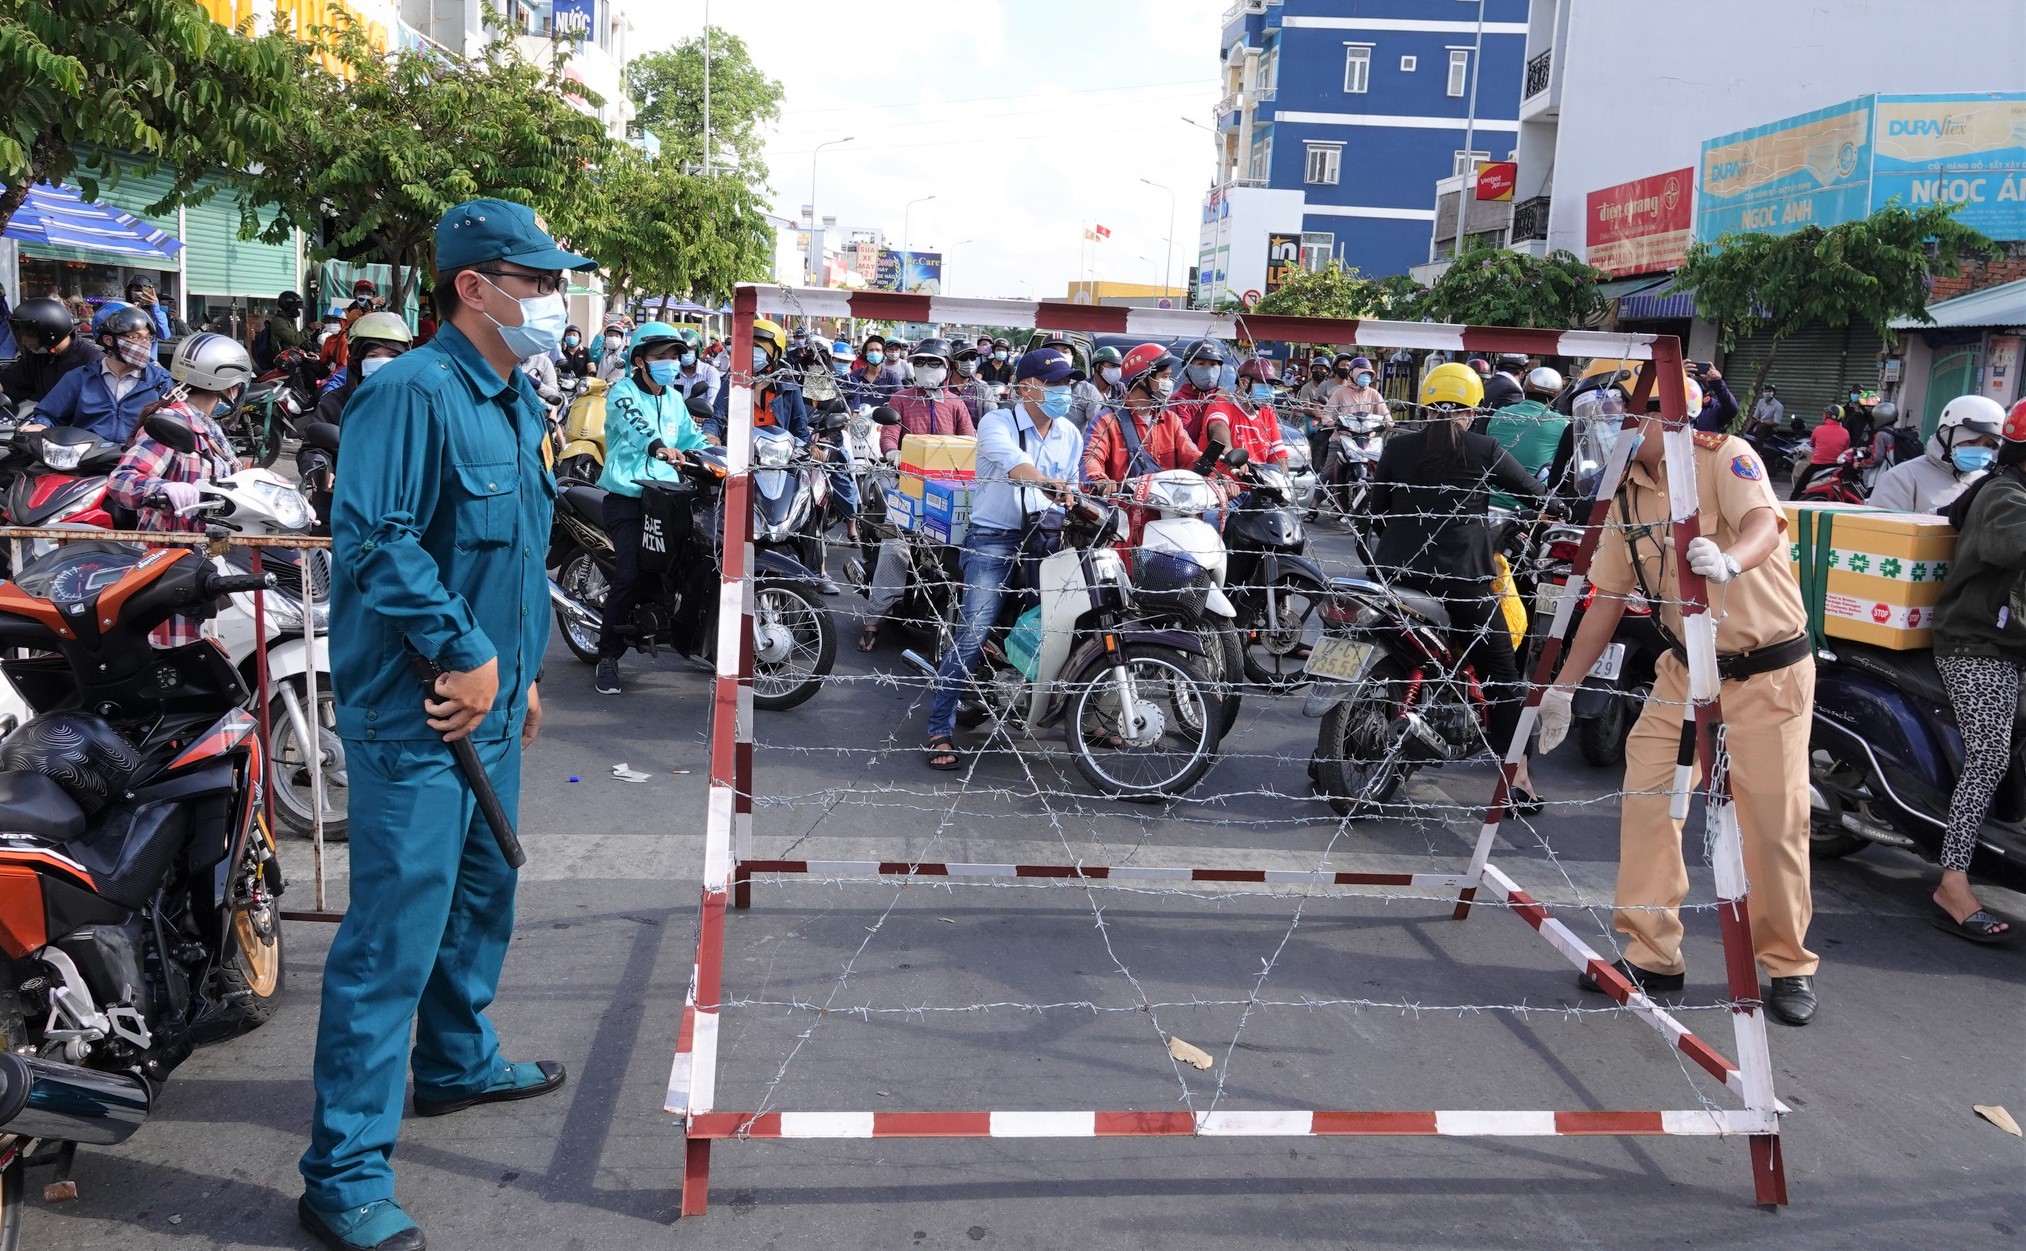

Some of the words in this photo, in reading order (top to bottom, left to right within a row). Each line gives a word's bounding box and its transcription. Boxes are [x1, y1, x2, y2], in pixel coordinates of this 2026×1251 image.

[642, 531, 666, 553] MIN
[1873, 608, 1889, 619] STOP
[1814, 700, 1857, 723] rande
